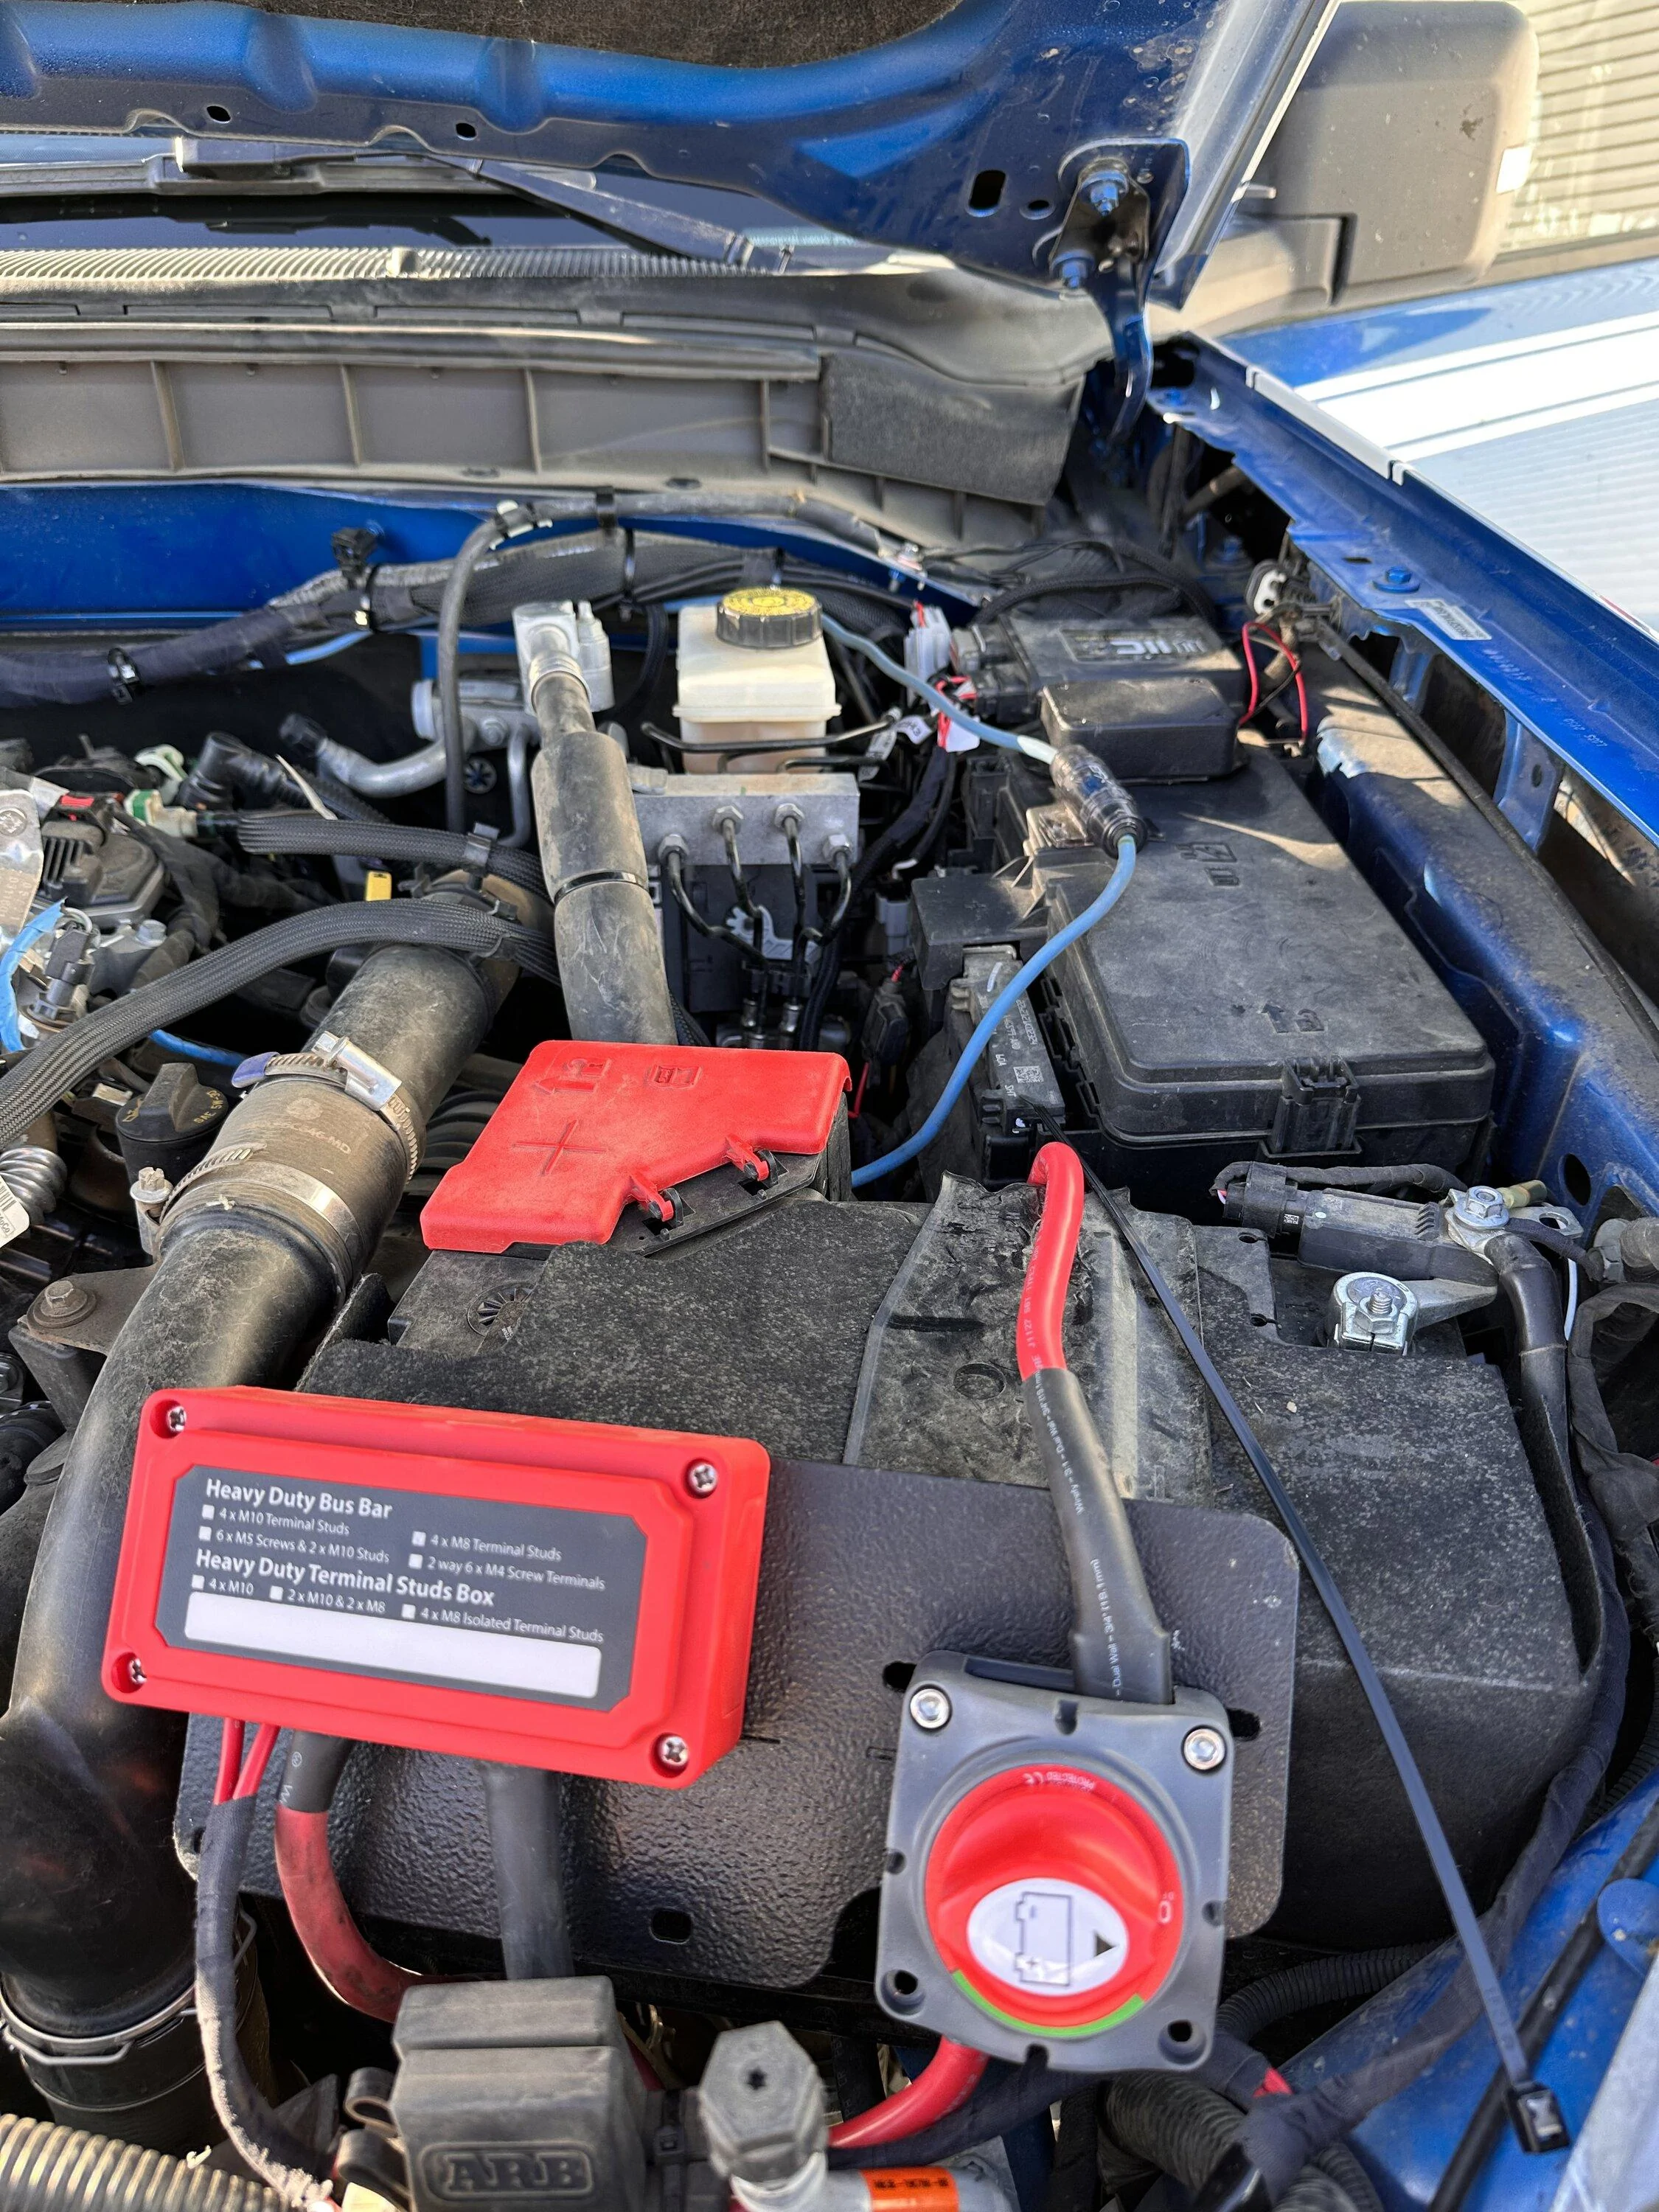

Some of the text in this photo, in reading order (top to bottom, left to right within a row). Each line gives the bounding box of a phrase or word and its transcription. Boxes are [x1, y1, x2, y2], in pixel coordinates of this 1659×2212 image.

[193, 1110, 217, 1124] SAE
[206, 1478, 393, 1519] Heavy Duty Bus Bar
[219, 1510, 350, 1537] 4 x M10 Terminal Studs
[215, 1529, 390, 1563] 6 x M5 Screws & 2 x M10 Studs
[431, 1534, 562, 1562] 4 x M8 Terminal Studs
[196, 1548, 495, 1607] Heavy Duty Terminal Studs Box
[209, 1579, 254, 1596] 4 x M10
[428, 1556, 606, 1591] 2 way 6 x M4 Screw Terminals
[288, 1589, 386, 1614] 2 x M10 & 2 x M8
[421, 1607, 605, 1644] 4 x M8 Isolated Terminal Studs
[1107, 1643, 1119, 1664] Wall
[1111, 1663, 1122, 1688] Dual
[444, 2151, 594, 2197] ARB
